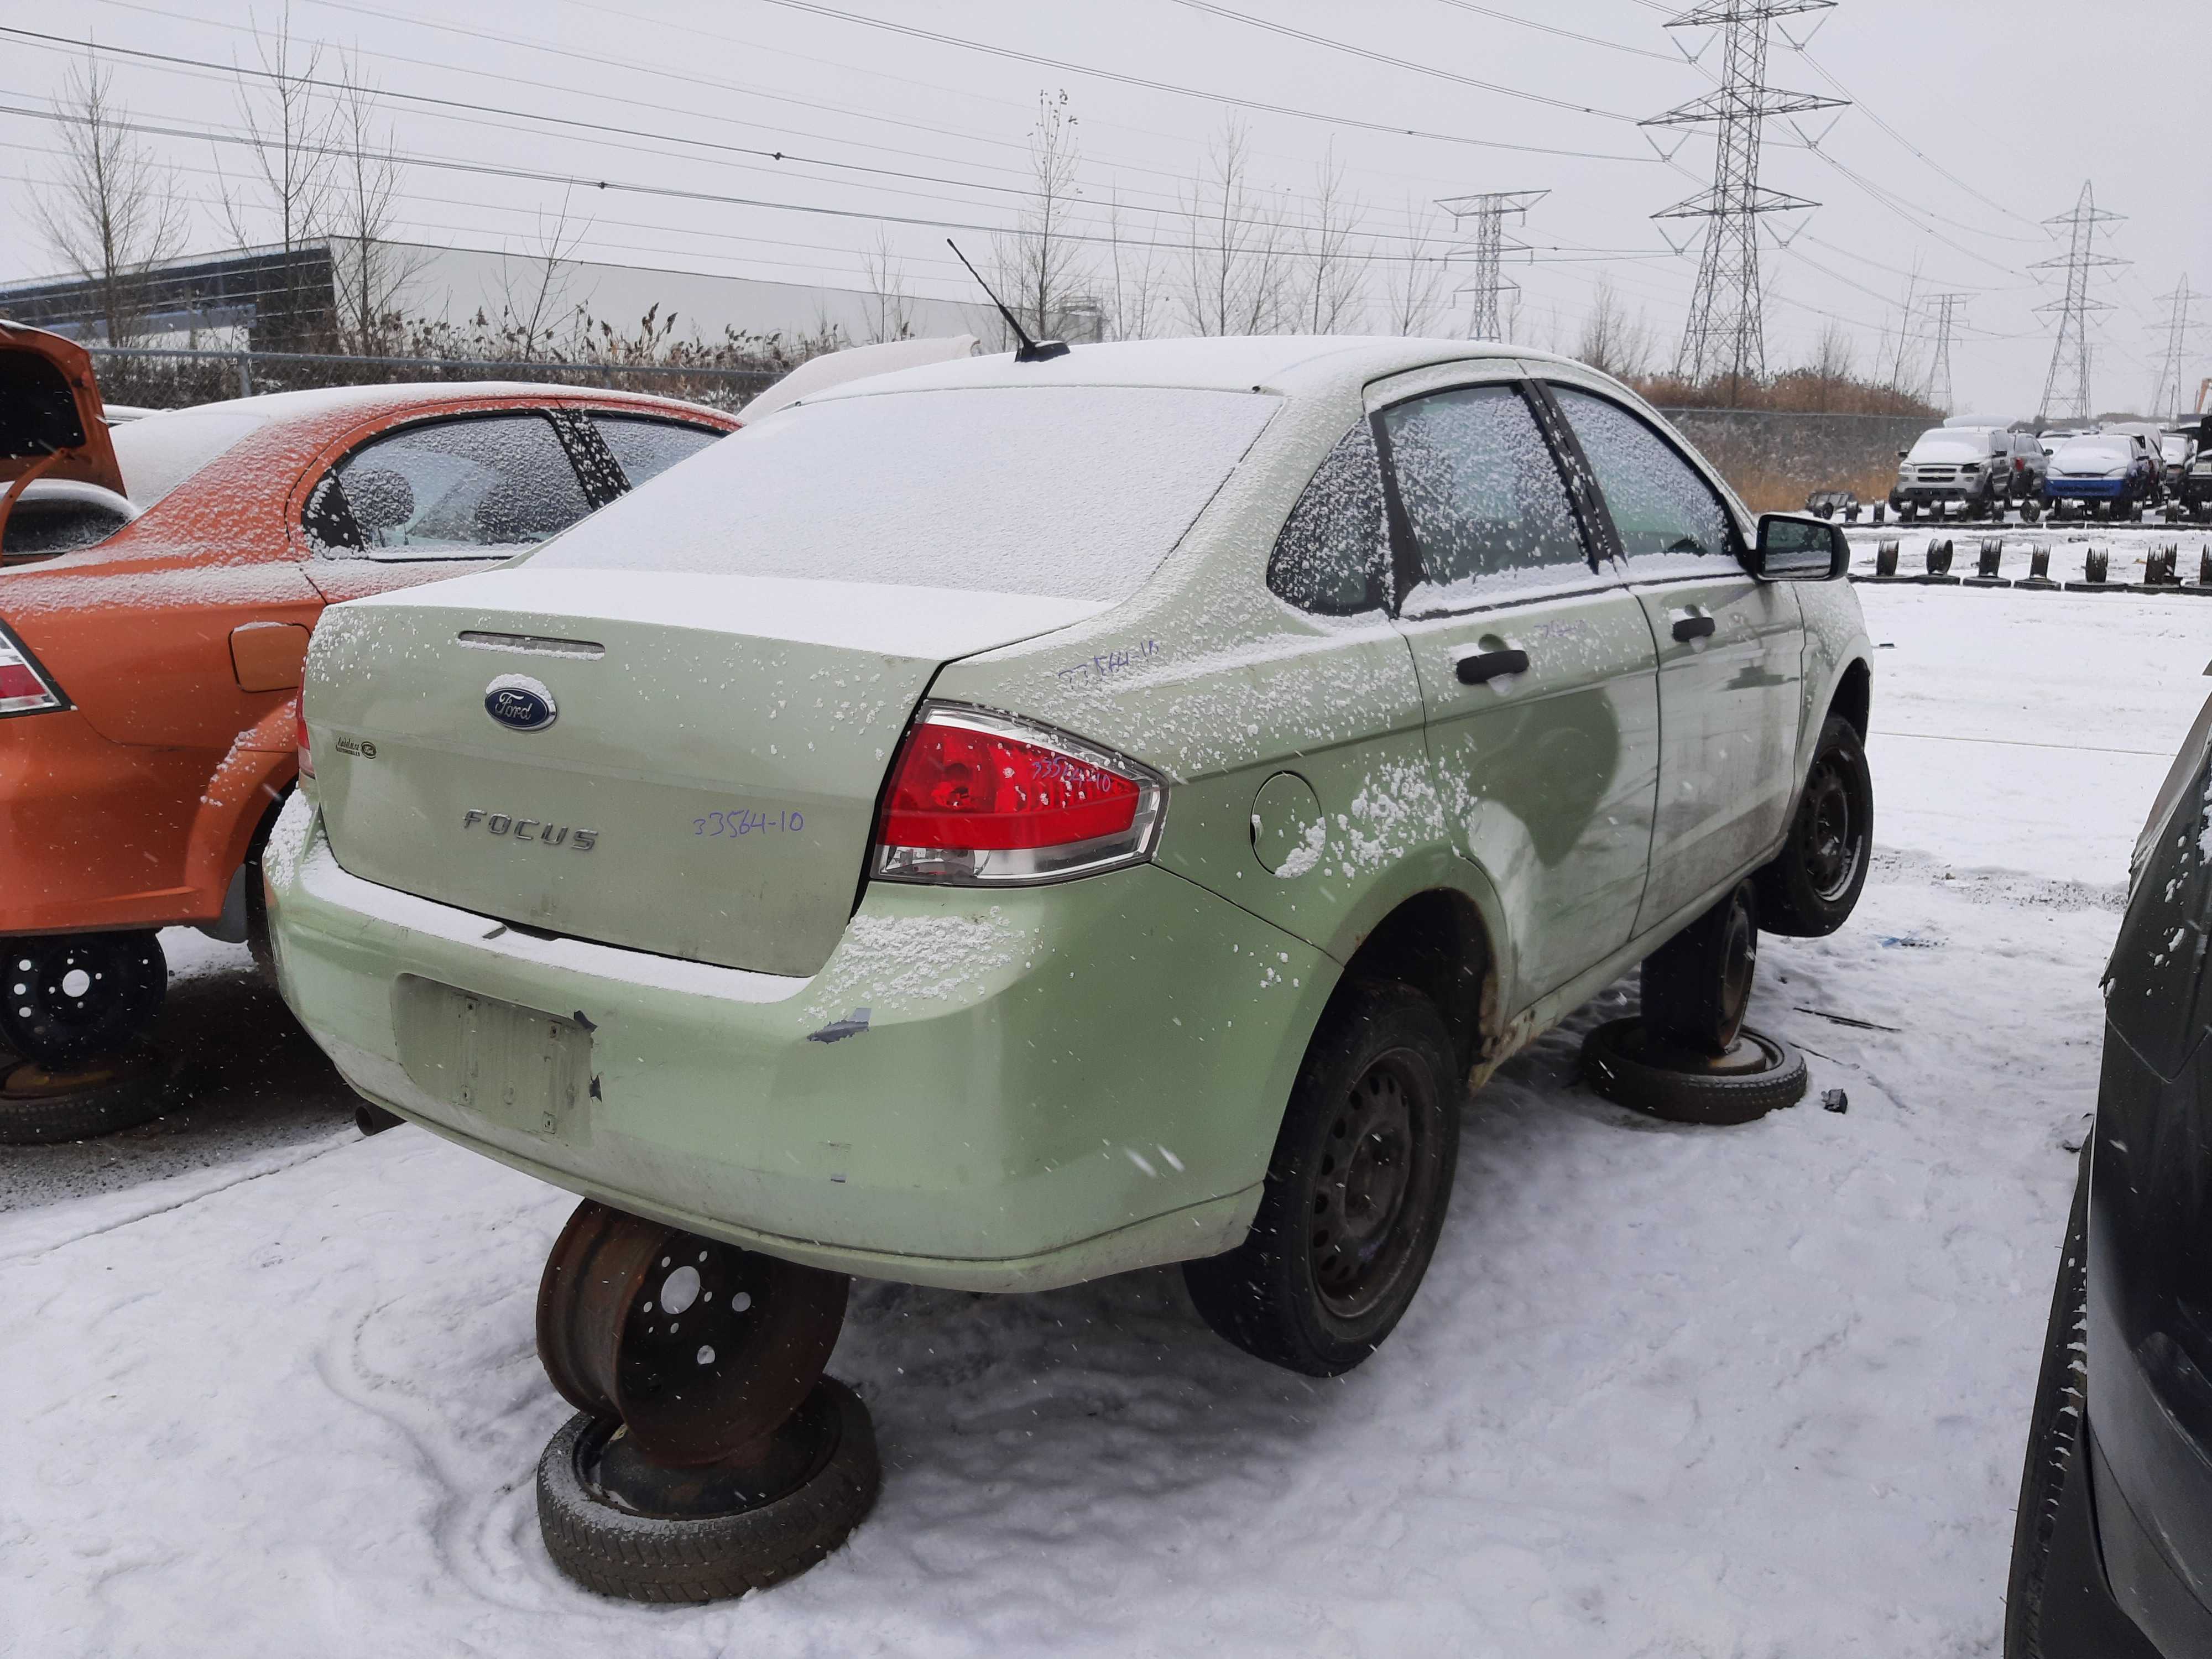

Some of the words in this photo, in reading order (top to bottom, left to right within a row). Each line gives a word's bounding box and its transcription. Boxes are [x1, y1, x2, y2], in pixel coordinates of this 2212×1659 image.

[495, 692, 533, 720] Ford
[462, 808, 599, 851] FOCUS
[693, 809, 804, 838] 33564-10
